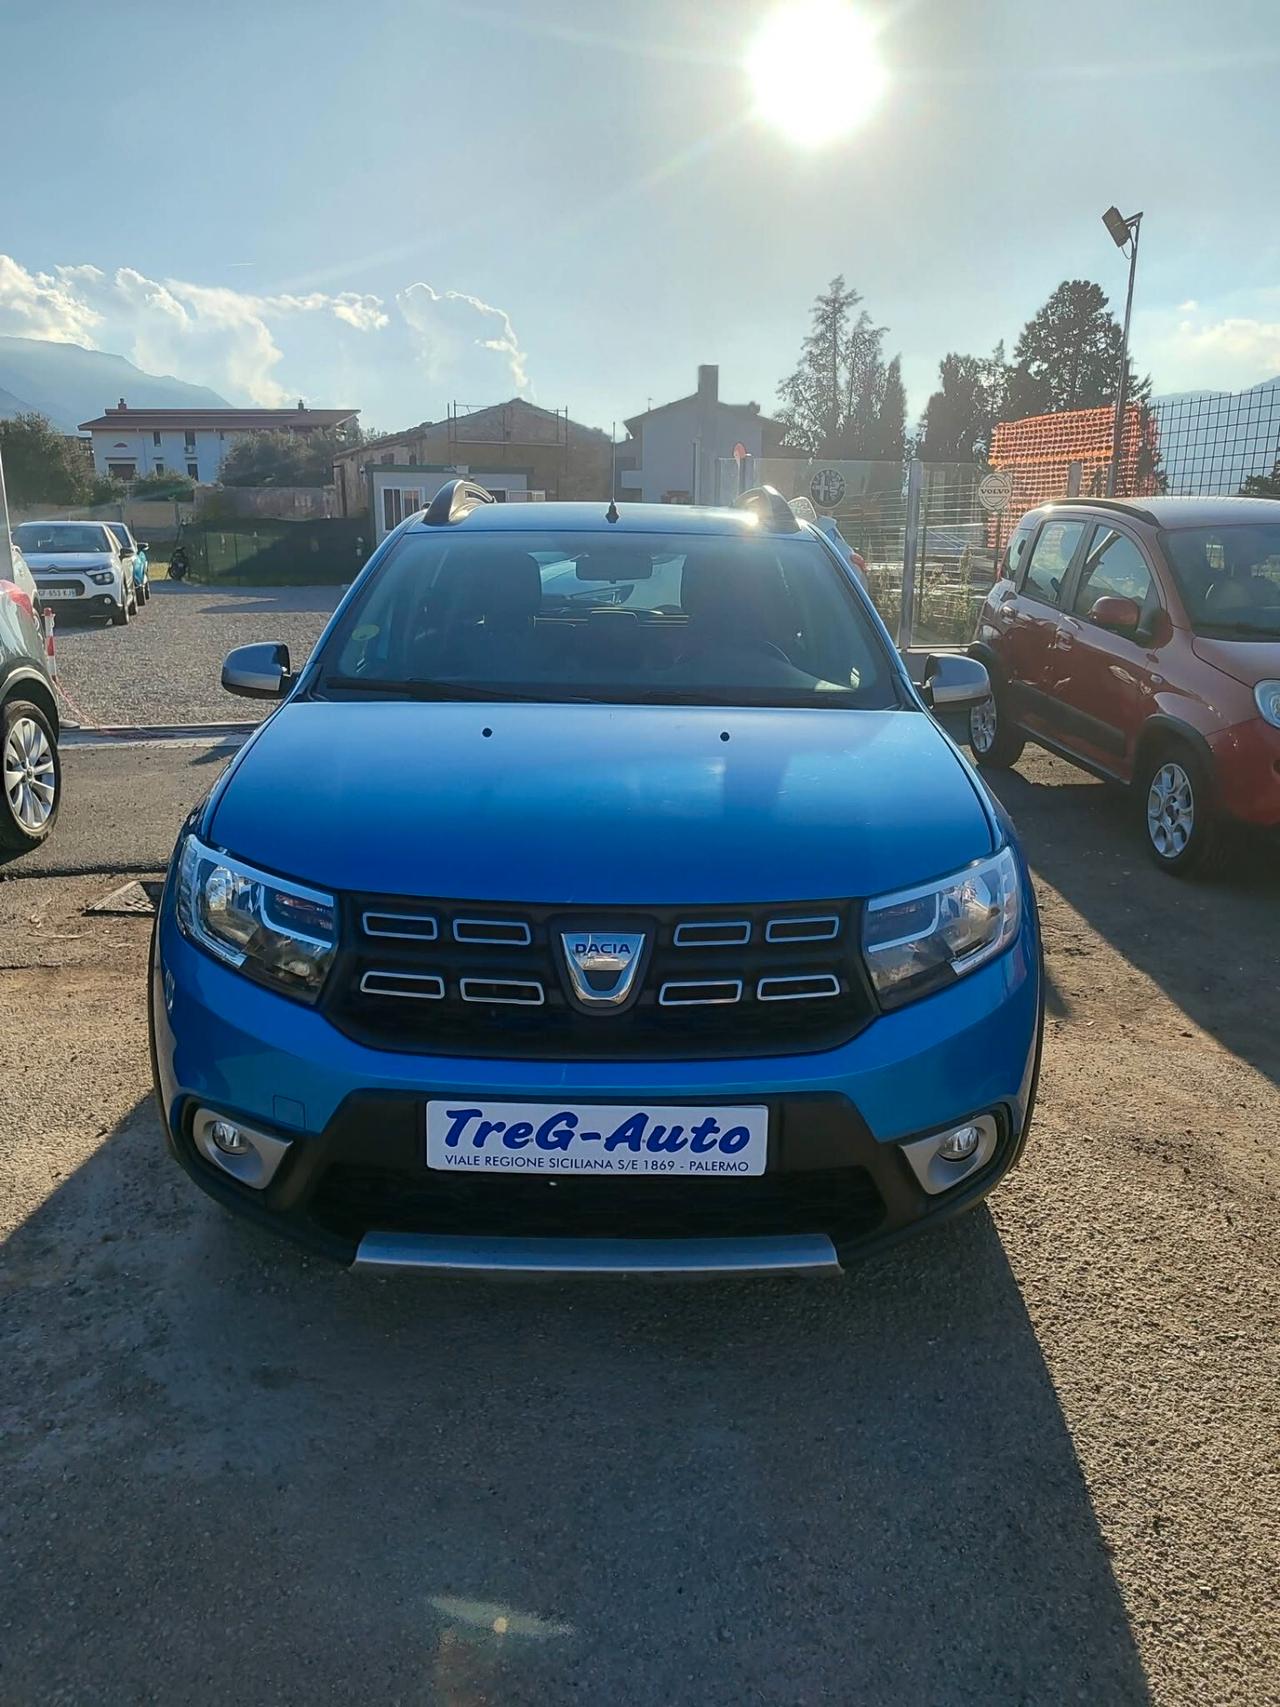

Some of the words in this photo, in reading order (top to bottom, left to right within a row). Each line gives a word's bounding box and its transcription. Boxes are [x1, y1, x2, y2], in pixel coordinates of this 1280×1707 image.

[575, 943, 631, 954] DACIA
[445, 1108, 750, 1154] TreG-Auto
[445, 1155, 481, 1166] VIALE
[484, 1156, 544, 1168] REGIONE
[549, 1157, 613, 1169] SICILIANA
[618, 1159, 639, 1170] S/E
[644, 1159, 675, 1171] 1869
[689, 1160, 749, 1172] PALERMO
